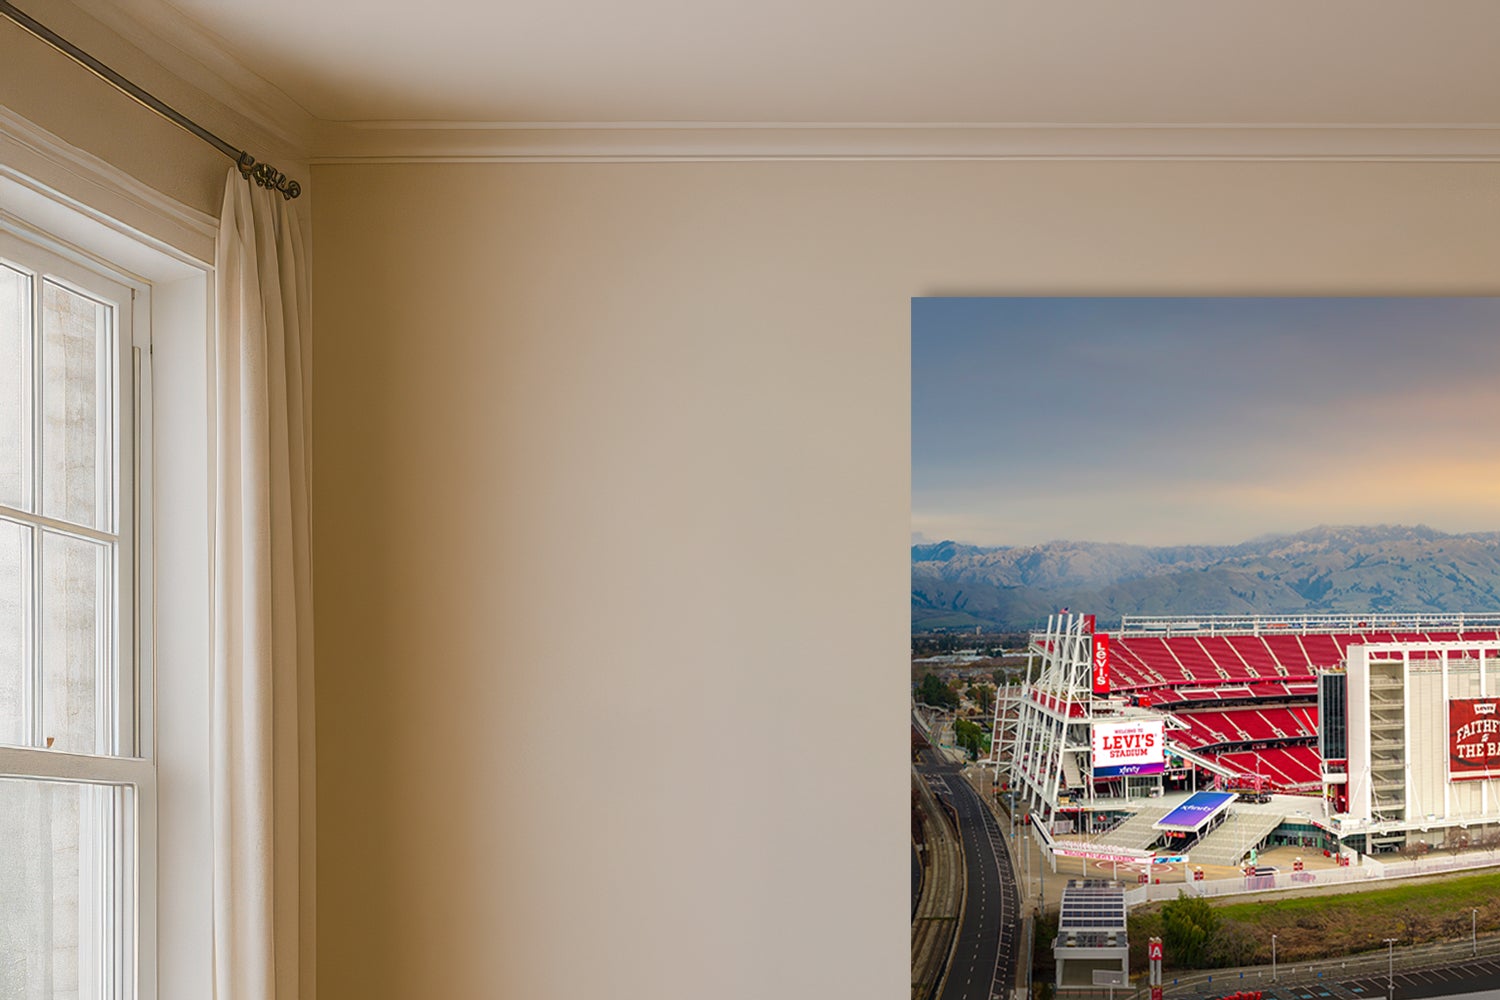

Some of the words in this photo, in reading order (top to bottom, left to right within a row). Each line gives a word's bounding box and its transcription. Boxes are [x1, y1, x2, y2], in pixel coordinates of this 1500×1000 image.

[1103, 733, 1154, 750] LEVI'S
[1110, 748, 1148, 758] STADIUM
[1456, 743, 1484, 758] THE
